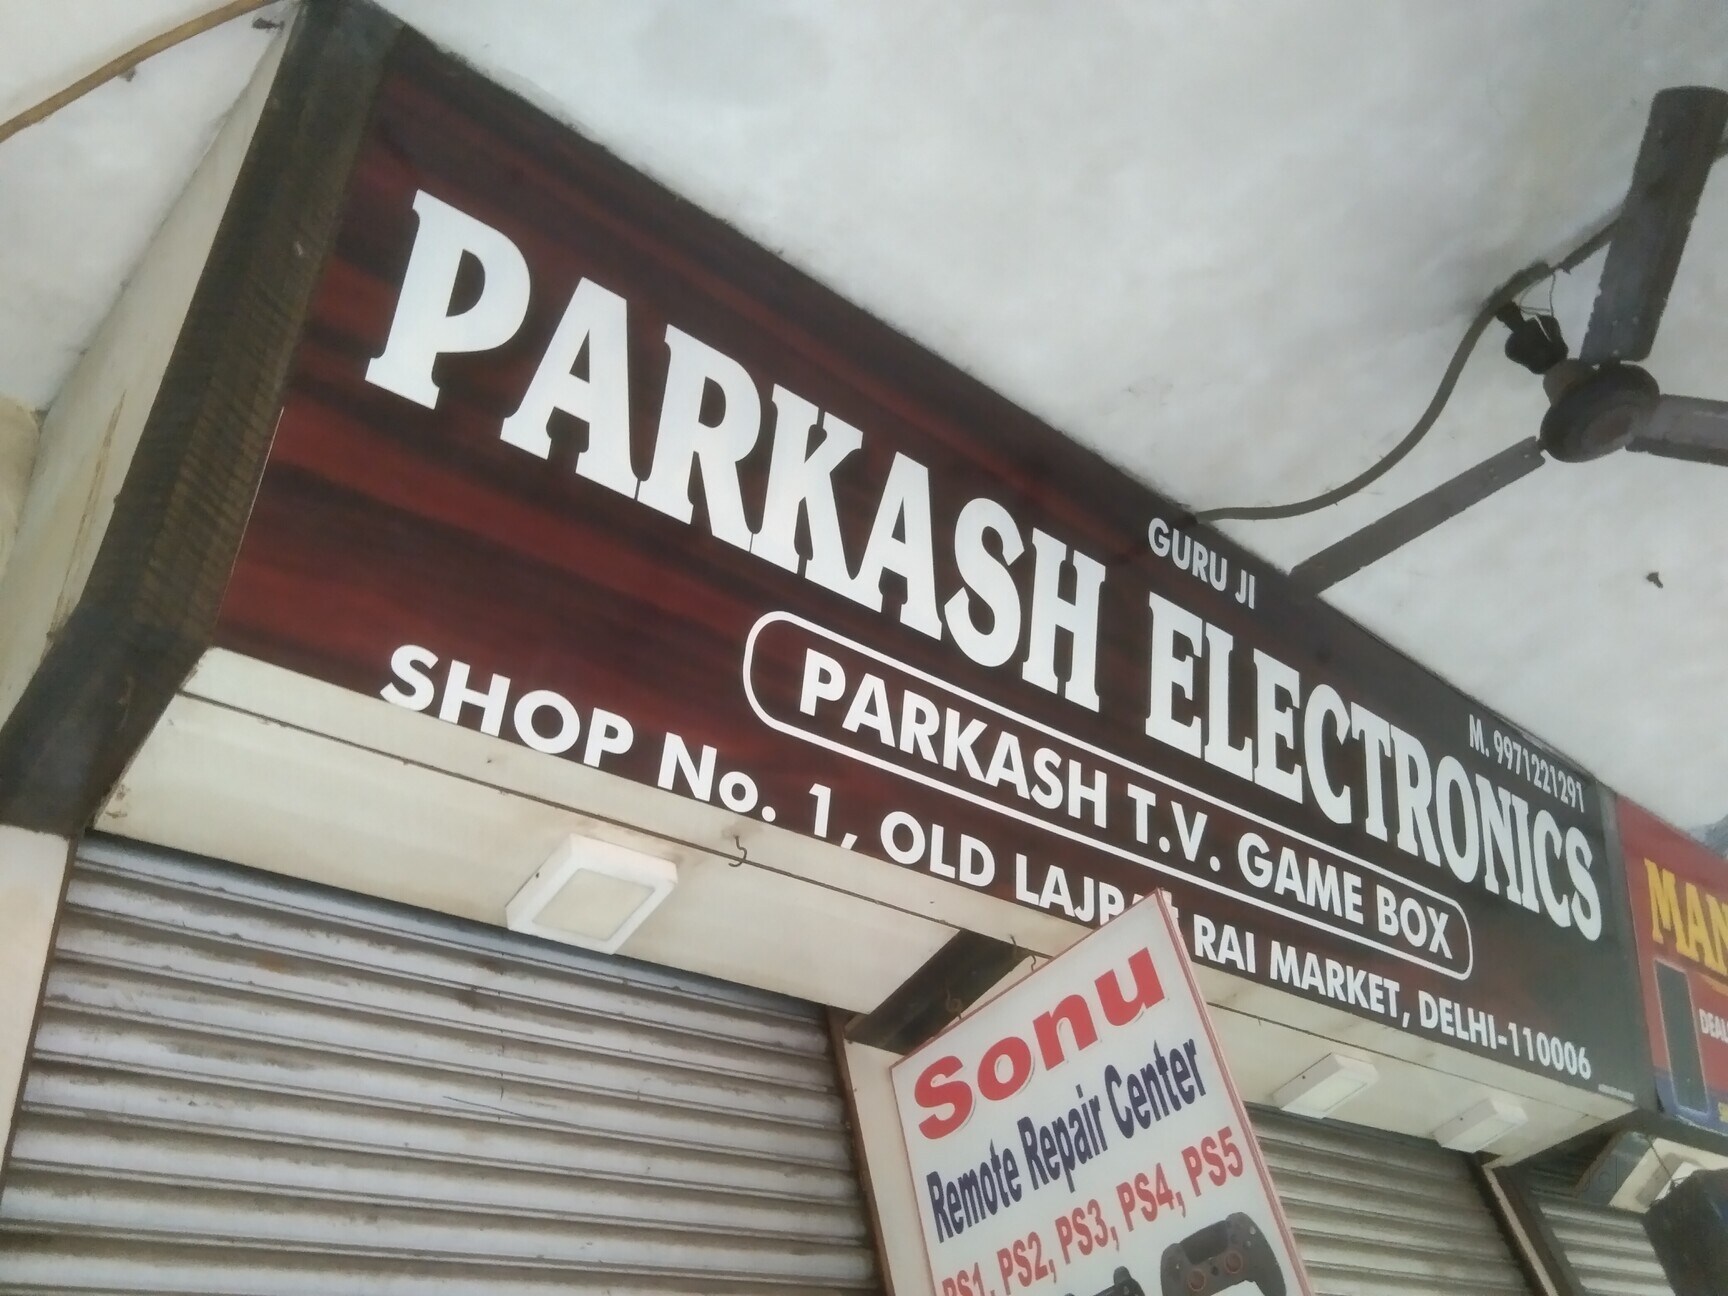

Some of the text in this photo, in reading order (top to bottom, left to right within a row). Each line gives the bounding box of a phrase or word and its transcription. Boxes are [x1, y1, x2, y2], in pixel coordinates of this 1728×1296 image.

[365, 189, 1602, 941] PARKASH ELECTRONICS
[1147, 517, 1256, 609] GURU JI
[379, 644, 634, 769] SHOP
[657, 731, 777, 823] No.
[879, 811, 996, 888] OLD
[1015, 852, 1180, 926] LAJP
[1193, 913, 1256, 974] RAI
[1418, 990, 1592, 1080] DELHI-110006
[799, 648, 1453, 960] PARKASH T.V. GAME BOX
[1469, 713, 1585, 813] M. 9971221291
[914, 946, 1165, 1141] Sonu
[926, 1038, 1208, 1244] Remote Repair Center
[996, 1231, 1057, 1296] PS2,
[1054, 1198, 1120, 1265] PS3,
[1115, 1162, 1187, 1232] PS4,
[1180, 1126, 1245, 1198] PS5
